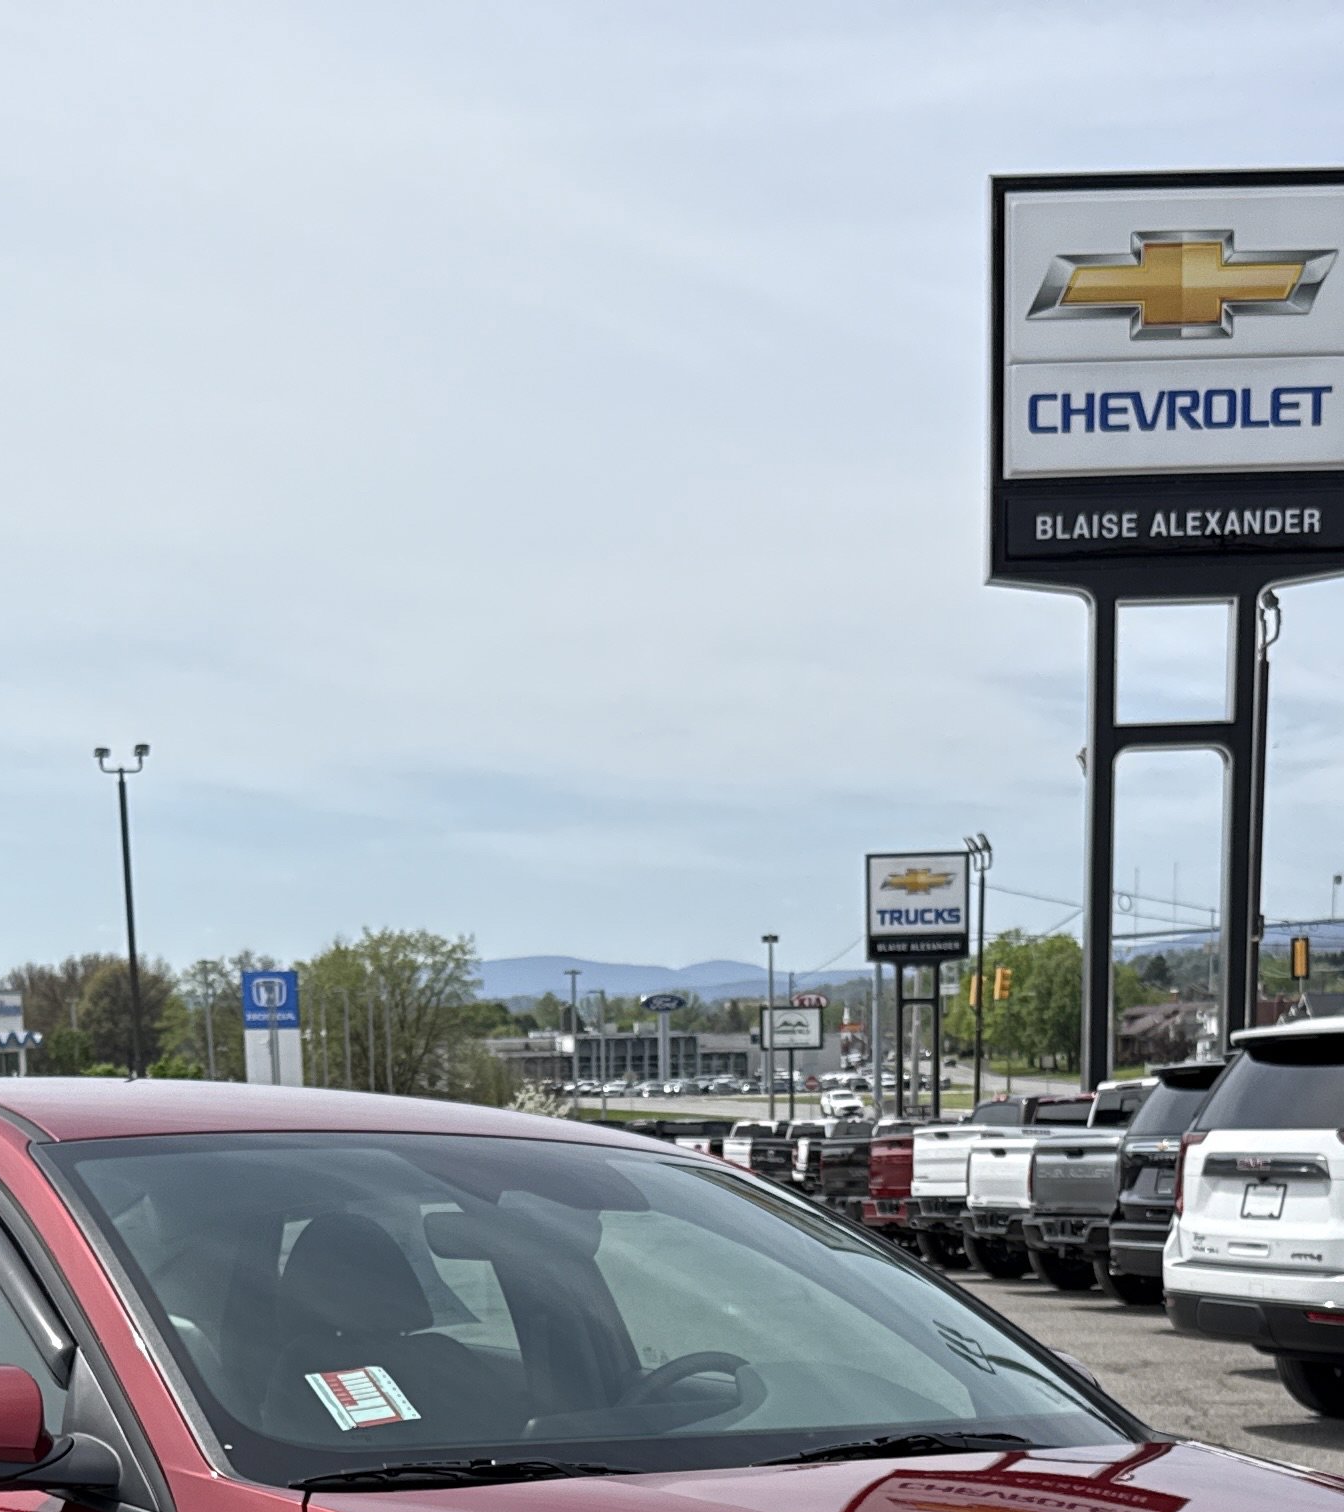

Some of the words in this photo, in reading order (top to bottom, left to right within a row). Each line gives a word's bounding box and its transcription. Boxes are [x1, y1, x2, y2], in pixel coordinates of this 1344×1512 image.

[1028, 385, 1333, 434] CHEVROLET
[1035, 513, 1138, 540] BLAISE
[1149, 508, 1322, 537] ALEXANDER
[876, 907, 961, 926] TRUCKS
